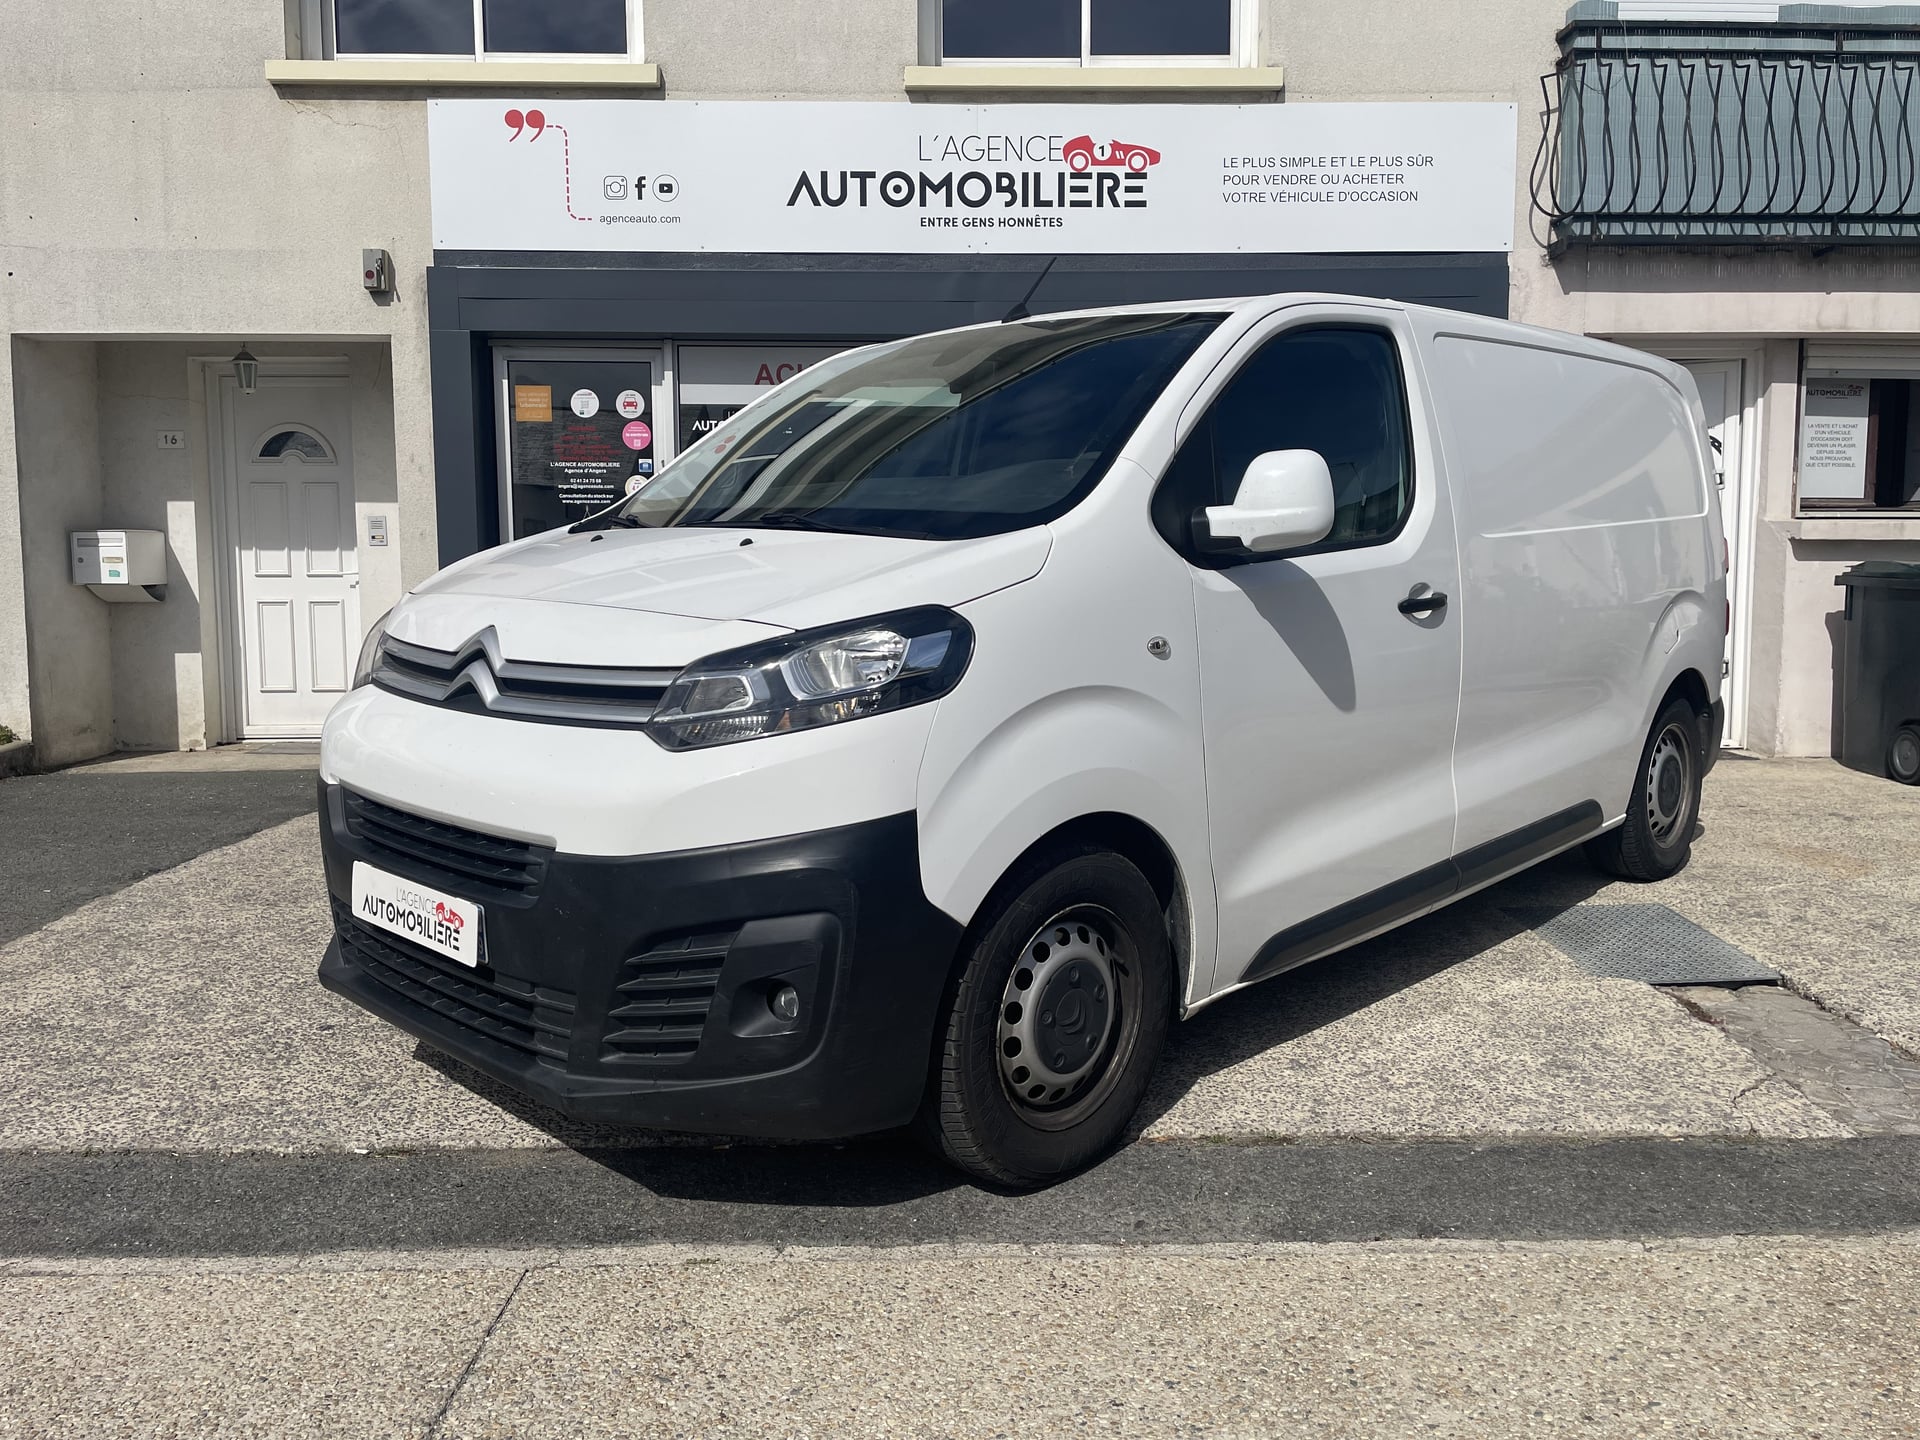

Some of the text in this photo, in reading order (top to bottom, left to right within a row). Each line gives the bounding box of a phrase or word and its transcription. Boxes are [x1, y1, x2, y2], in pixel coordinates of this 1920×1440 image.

[918, 135, 1064, 162] L'AGENCE
[1223, 153, 1434, 168] LE PLUS SIMPLE ET LE PLUS SÛR
[1223, 173, 1405, 186] POUR VENDRE OU ACHETER
[1222, 189, 1418, 203] VOTRE VÉHICULE D'OCCASION
[599, 213, 681, 226] agenceauto.com
[920, 214, 1063, 228] ENTRE GENS HONNÊTES
[164, 434, 178, 445] 16
[395, 887, 437, 916] L'AGENCE
